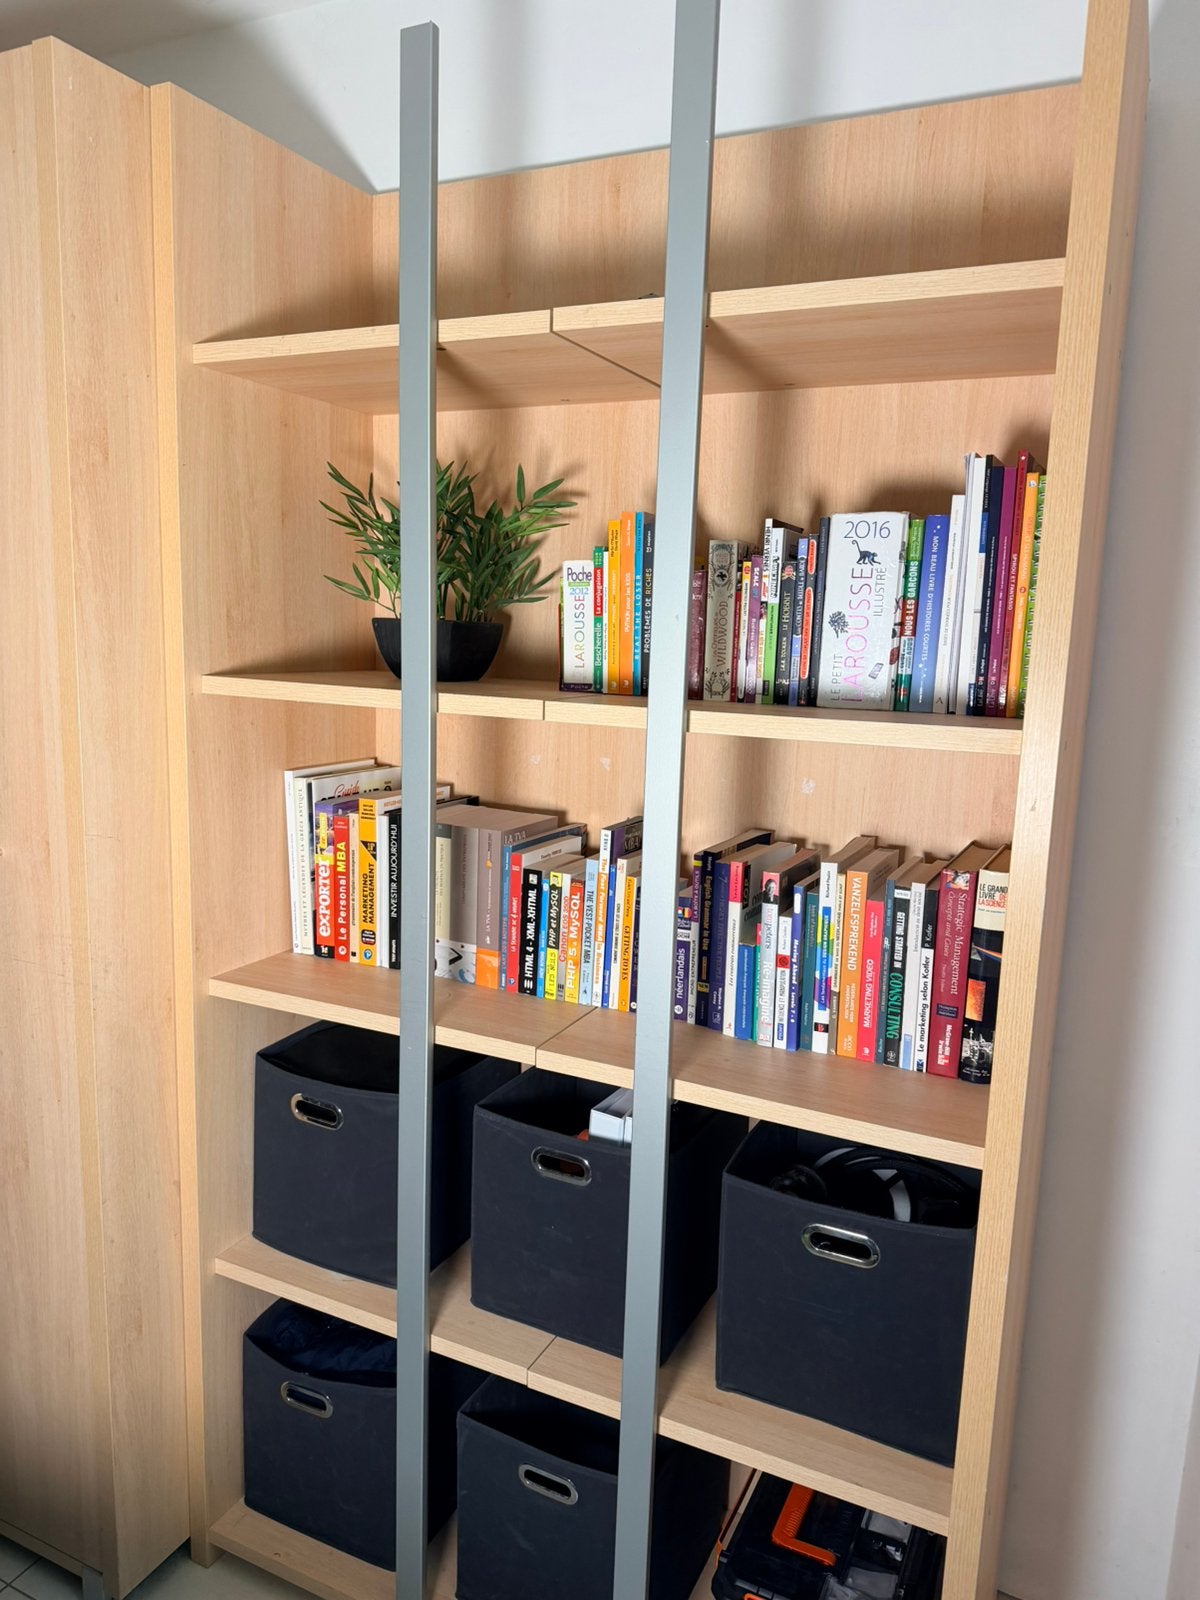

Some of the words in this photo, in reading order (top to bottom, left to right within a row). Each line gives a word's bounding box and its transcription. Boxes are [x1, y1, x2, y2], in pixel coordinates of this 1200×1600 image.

[844, 520, 891, 539] 2016
[567, 566, 592, 582] Poche
[930, 553, 938, 572] BEAU
[569, 588, 589, 596] 2012
[645, 568, 653, 595] RICHES
[928, 573, 936, 594] LIVRE
[596, 606, 601, 615] La
[645, 599, 652, 607] DE
[783, 592, 791, 621] HOBBIT
[906, 599, 915, 614] LES
[925, 595, 934, 632] D'HISTOIRES
[574, 595, 585, 668] LAROUSSE
[717, 601, 728, 667] WILDWOOD
[782, 622, 787, 630] LE
[841, 567, 875, 703] LAROUSSE
[904, 613, 914, 636] NOUS
[595, 622, 603, 667] Bescherelle
[922, 633, 930, 661] COURTES
[832, 654, 843, 684] PETIT
[831, 685, 839, 701] LE
[505, 834, 513, 845] LA
[514, 831, 527, 841] TVA
[336, 841, 346, 873] MBA
[599, 873, 607, 889] Fast
[979, 883, 986, 891] LE
[987, 885, 1008, 893] GRAND
[338, 875, 347, 924] Personal
[551, 889, 559, 919] MySQL
[597, 890, 606, 921] Forward
[979, 891, 996, 899] LIVRE
[986, 900, 1007, 908] SCIENCE
[527, 888, 537, 936] XML-XHTML
[570, 892, 581, 940] MySQL
[703, 900, 711, 928] Grammar
[847, 877, 862, 971] VANZELFSPREKEND
[897, 912, 905, 935] GETTING
[956, 892, 968, 932] Strategic
[338, 927, 347, 941] Le
[550, 921, 557, 929] et
[584, 904, 594, 949] VEST-POCKET
[596, 923, 604, 942] MBA
[526, 945, 534, 953] 4
[548, 930, 556, 948] PHP
[558, 933, 567, 963] Canon
[596, 942, 602, 950] in
[622, 925, 630, 956] GETTING
[895, 936, 903, 960] STARTED
[569, 948, 577, 958] 5
[950, 934, 965, 995] Management
[525, 954, 534, 978] HTML
[566, 960, 576, 989] PHP
[594, 951, 602, 985] Business
[676, 948, 685, 999] néerlandais
[922, 956, 930, 979] Kotler
[863, 984, 872, 1028] MARKETING
[886, 972, 904, 1039] CONSULTING
[919, 1003, 928, 1043] marketing
[917, 1044, 923, 1053] Le
